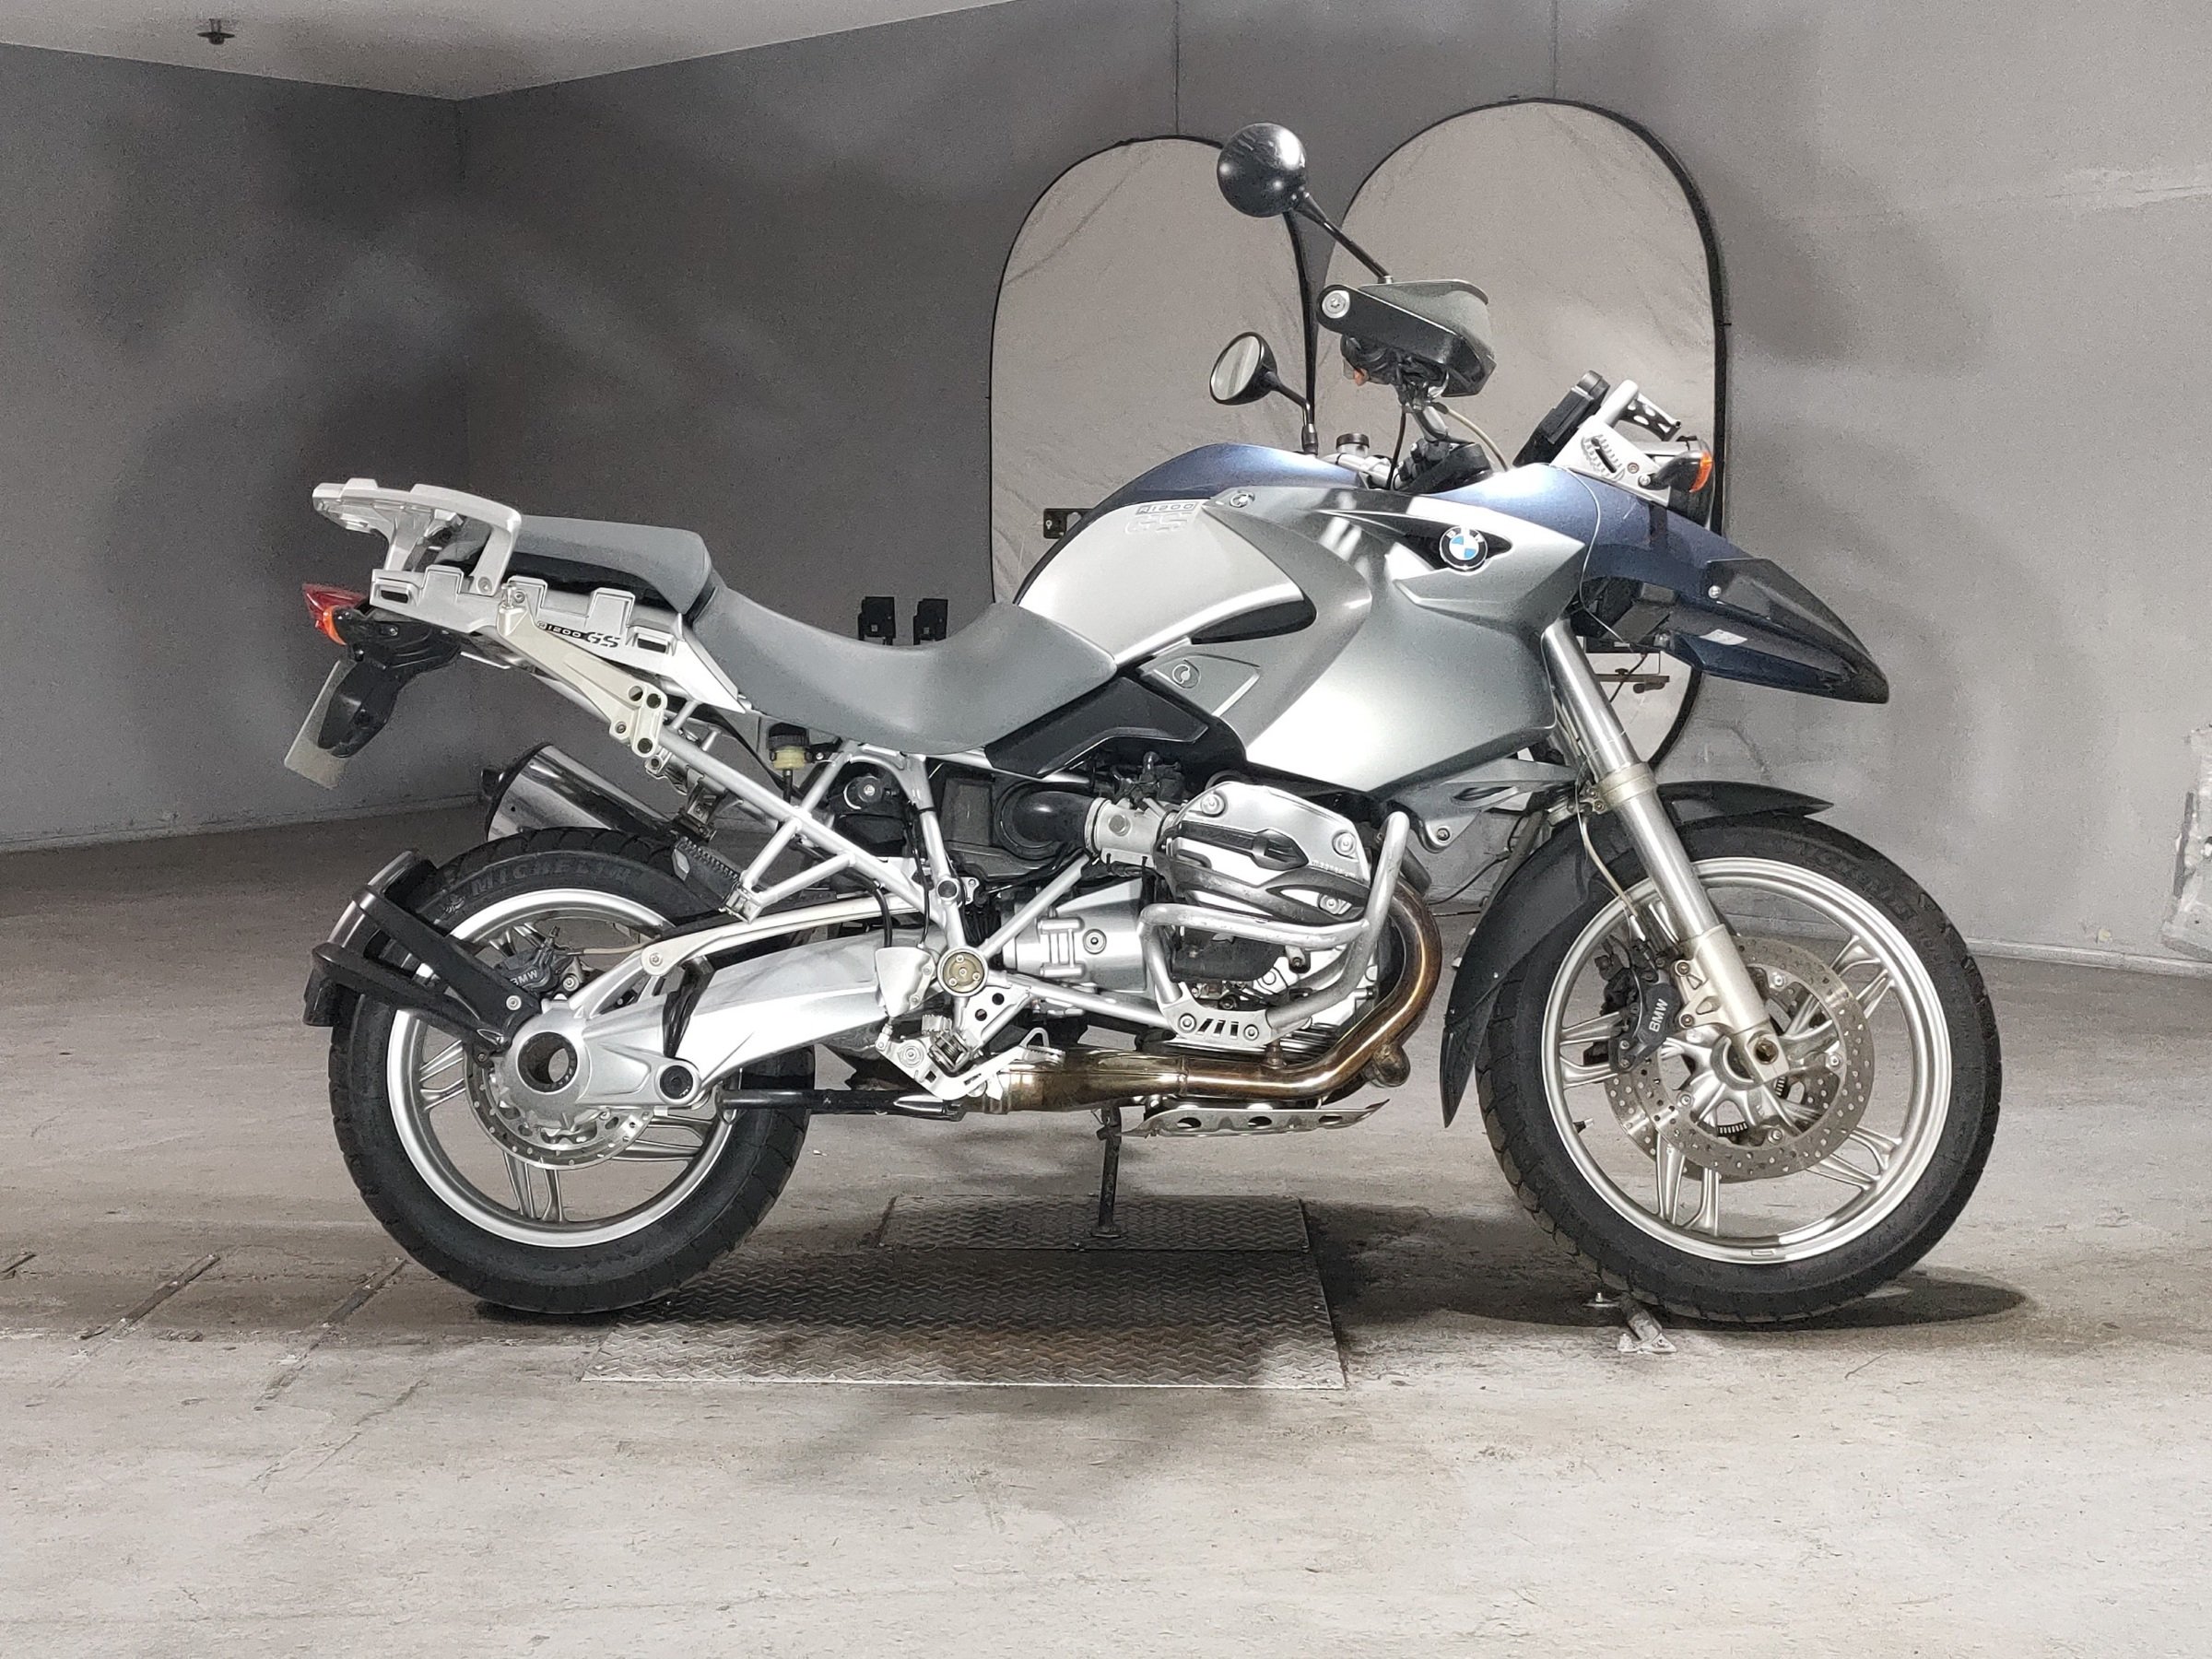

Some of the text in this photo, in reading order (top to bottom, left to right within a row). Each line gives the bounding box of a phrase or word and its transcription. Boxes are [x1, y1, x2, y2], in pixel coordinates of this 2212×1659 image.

[586, 631, 621, 648] GS
[470, 858, 633, 897] MICHELIN
[1649, 998, 1668, 1032] BMW
